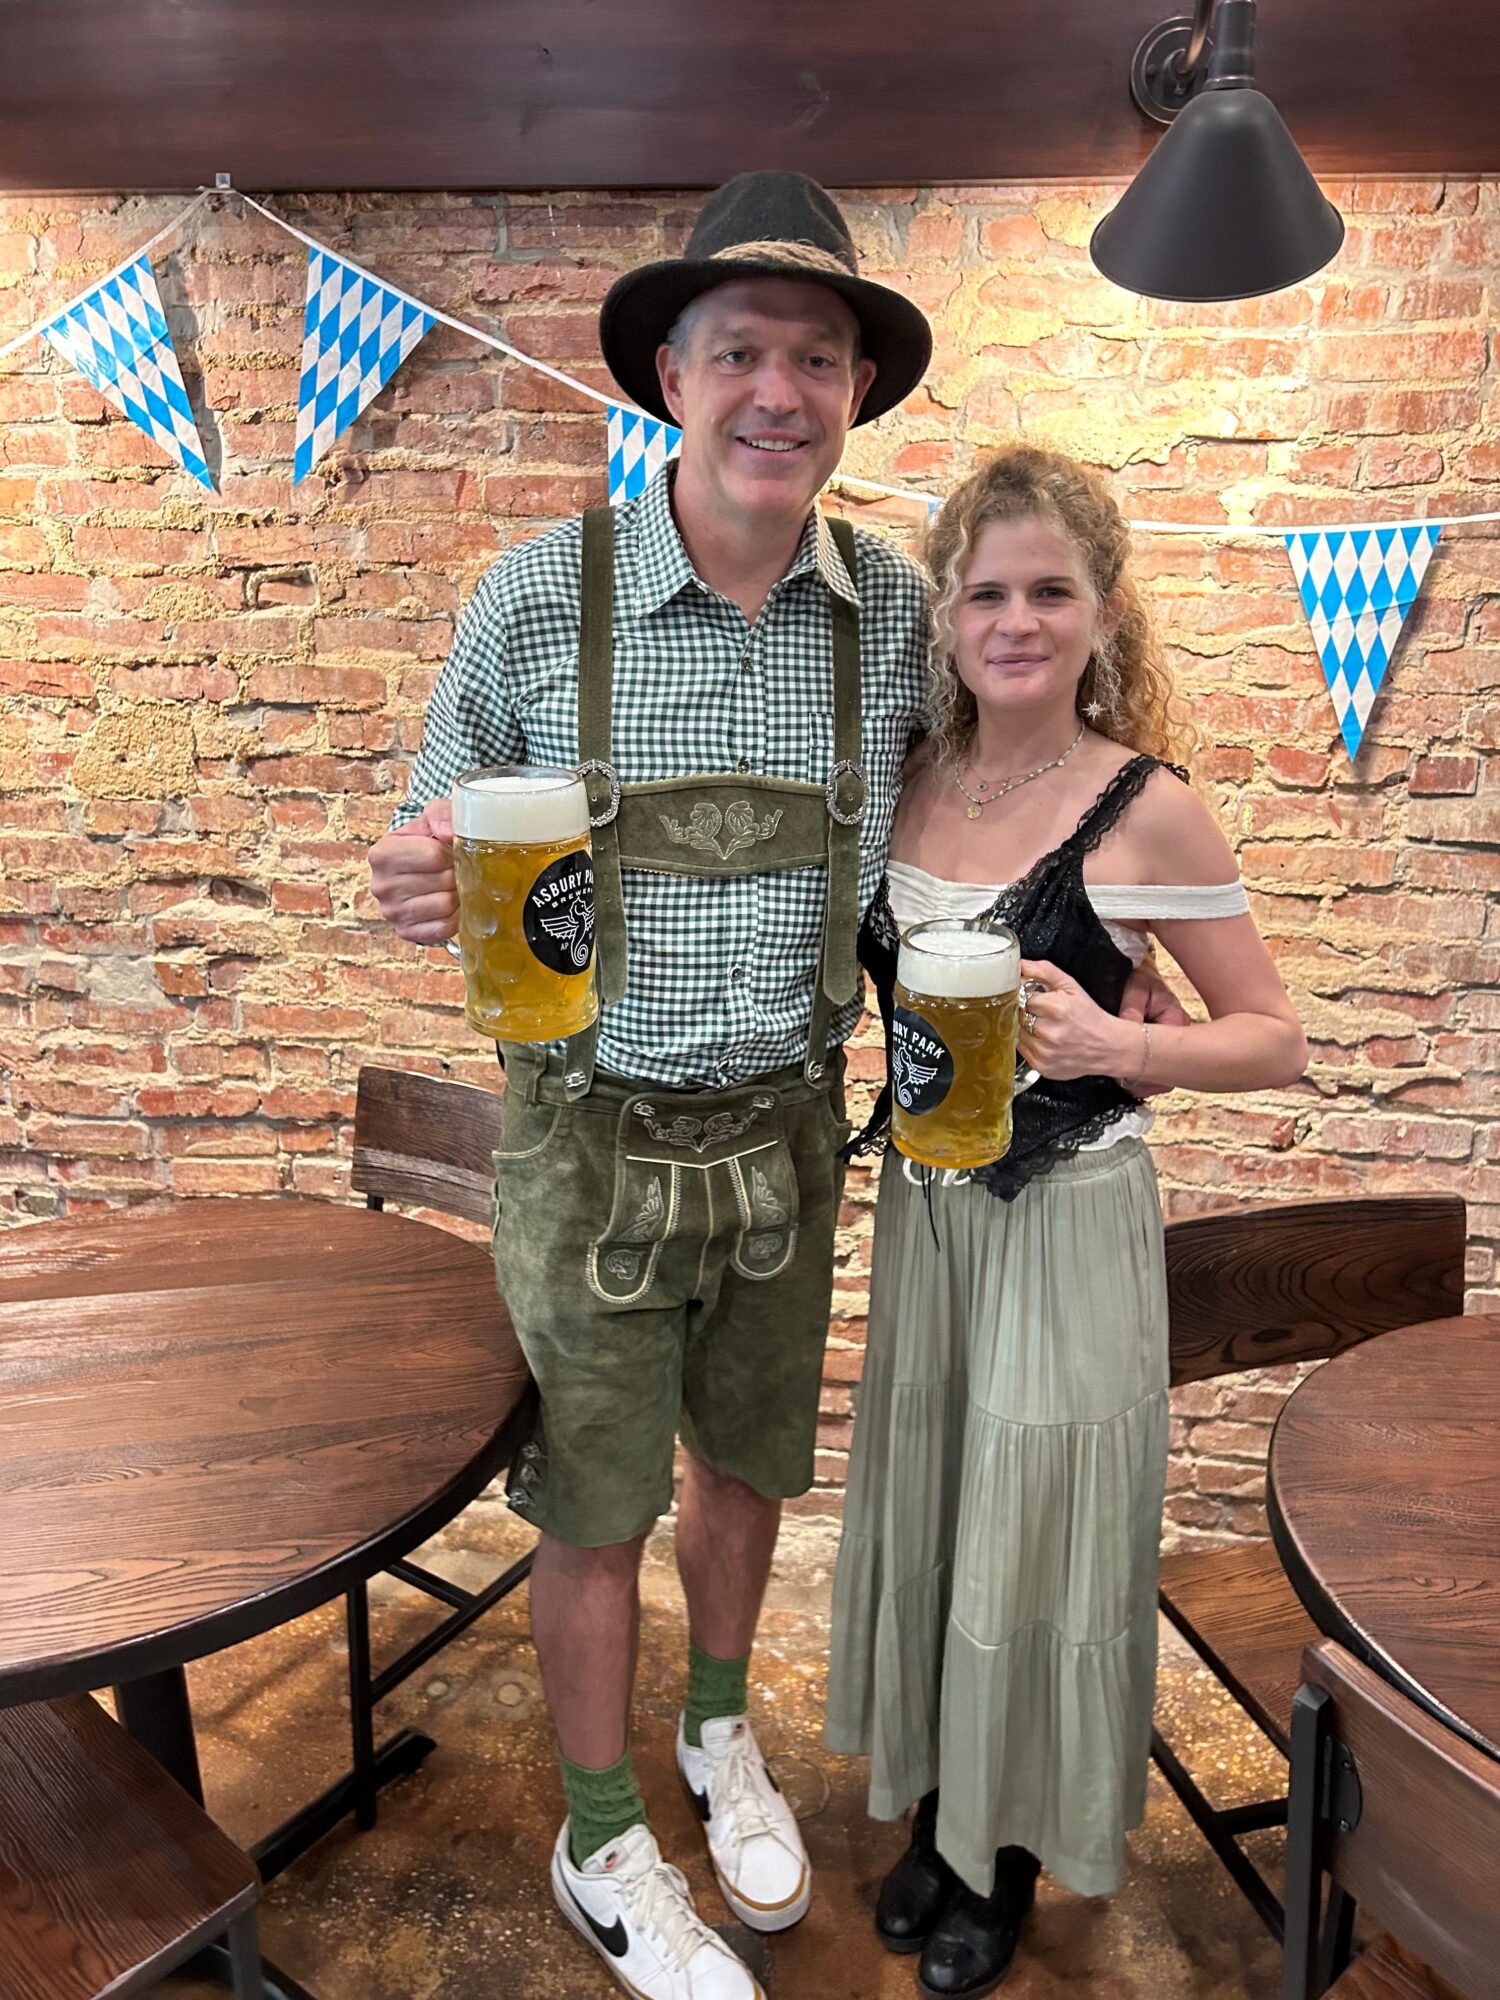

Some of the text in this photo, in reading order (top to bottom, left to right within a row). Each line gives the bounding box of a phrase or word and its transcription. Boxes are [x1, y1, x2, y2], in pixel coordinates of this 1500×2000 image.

[532, 869, 594, 908] ASBURY PA
[551, 887, 593, 908] BREWER
[560, 942, 569, 951] AP
[893, 1019, 945, 1060] URY PARK
